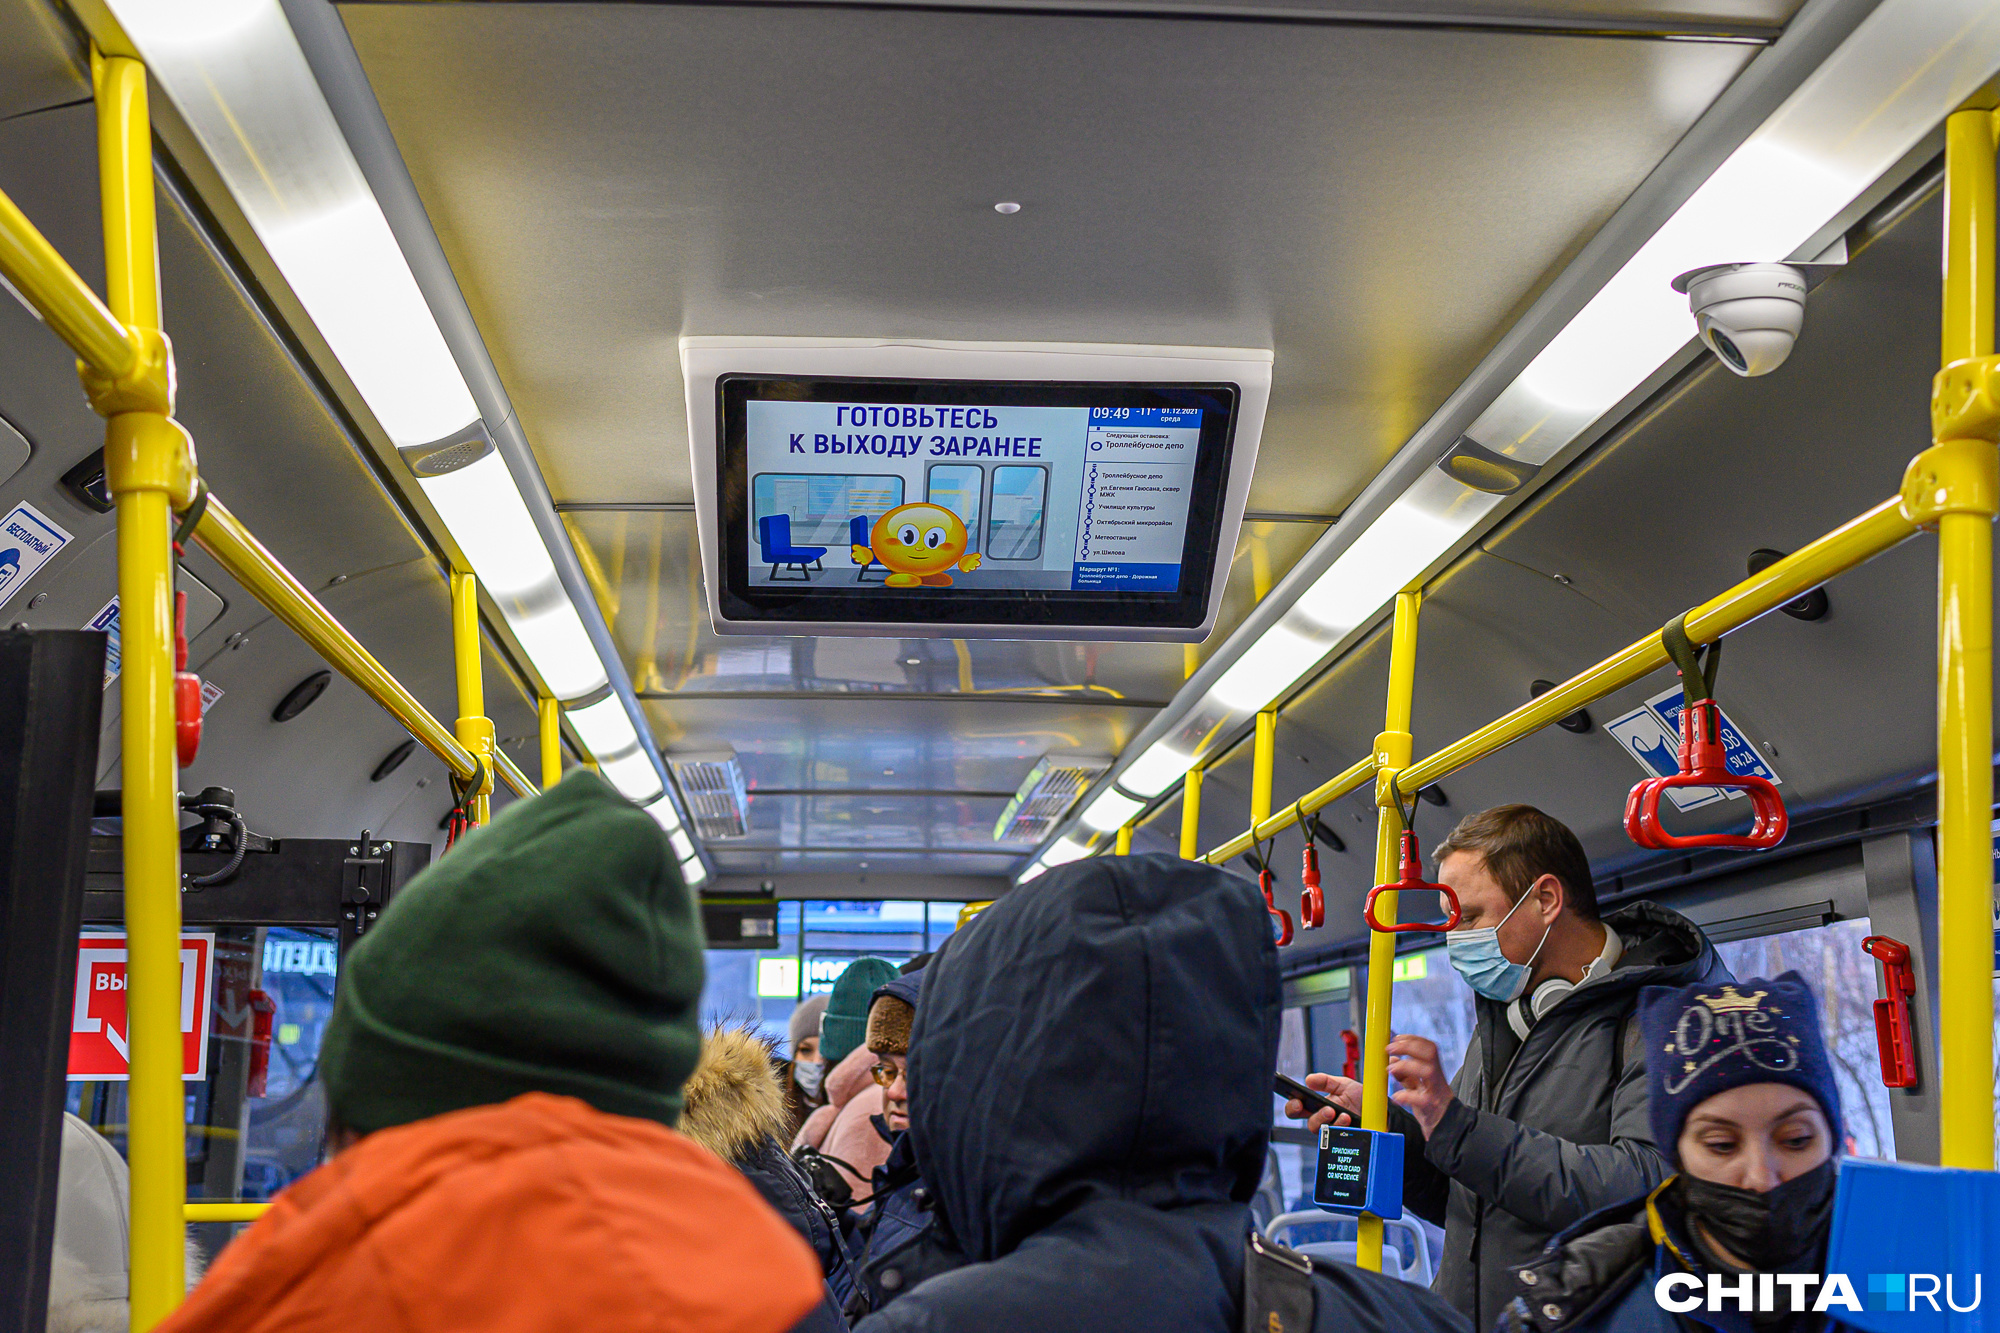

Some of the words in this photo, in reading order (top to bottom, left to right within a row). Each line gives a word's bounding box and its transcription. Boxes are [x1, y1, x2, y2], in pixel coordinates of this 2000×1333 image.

[836, 406, 998, 429] ГОТОВЬТЕСЬ
[1093, 407, 1130, 419] 09:49
[789, 433, 806, 454] К
[814, 434, 923, 458] ВЫХОДУ
[929, 436, 1042, 458] ЗАРАНЕЕ
[1105, 440, 1164, 450] Троллейбусное
[1165, 442, 1185, 450] депо
[1102, 472, 1147, 480] Троллейбусное
[5, 522, 53, 556] БЕСПЛАТНЫЙ
[1729, 750, 1756, 769] 5V,2A
